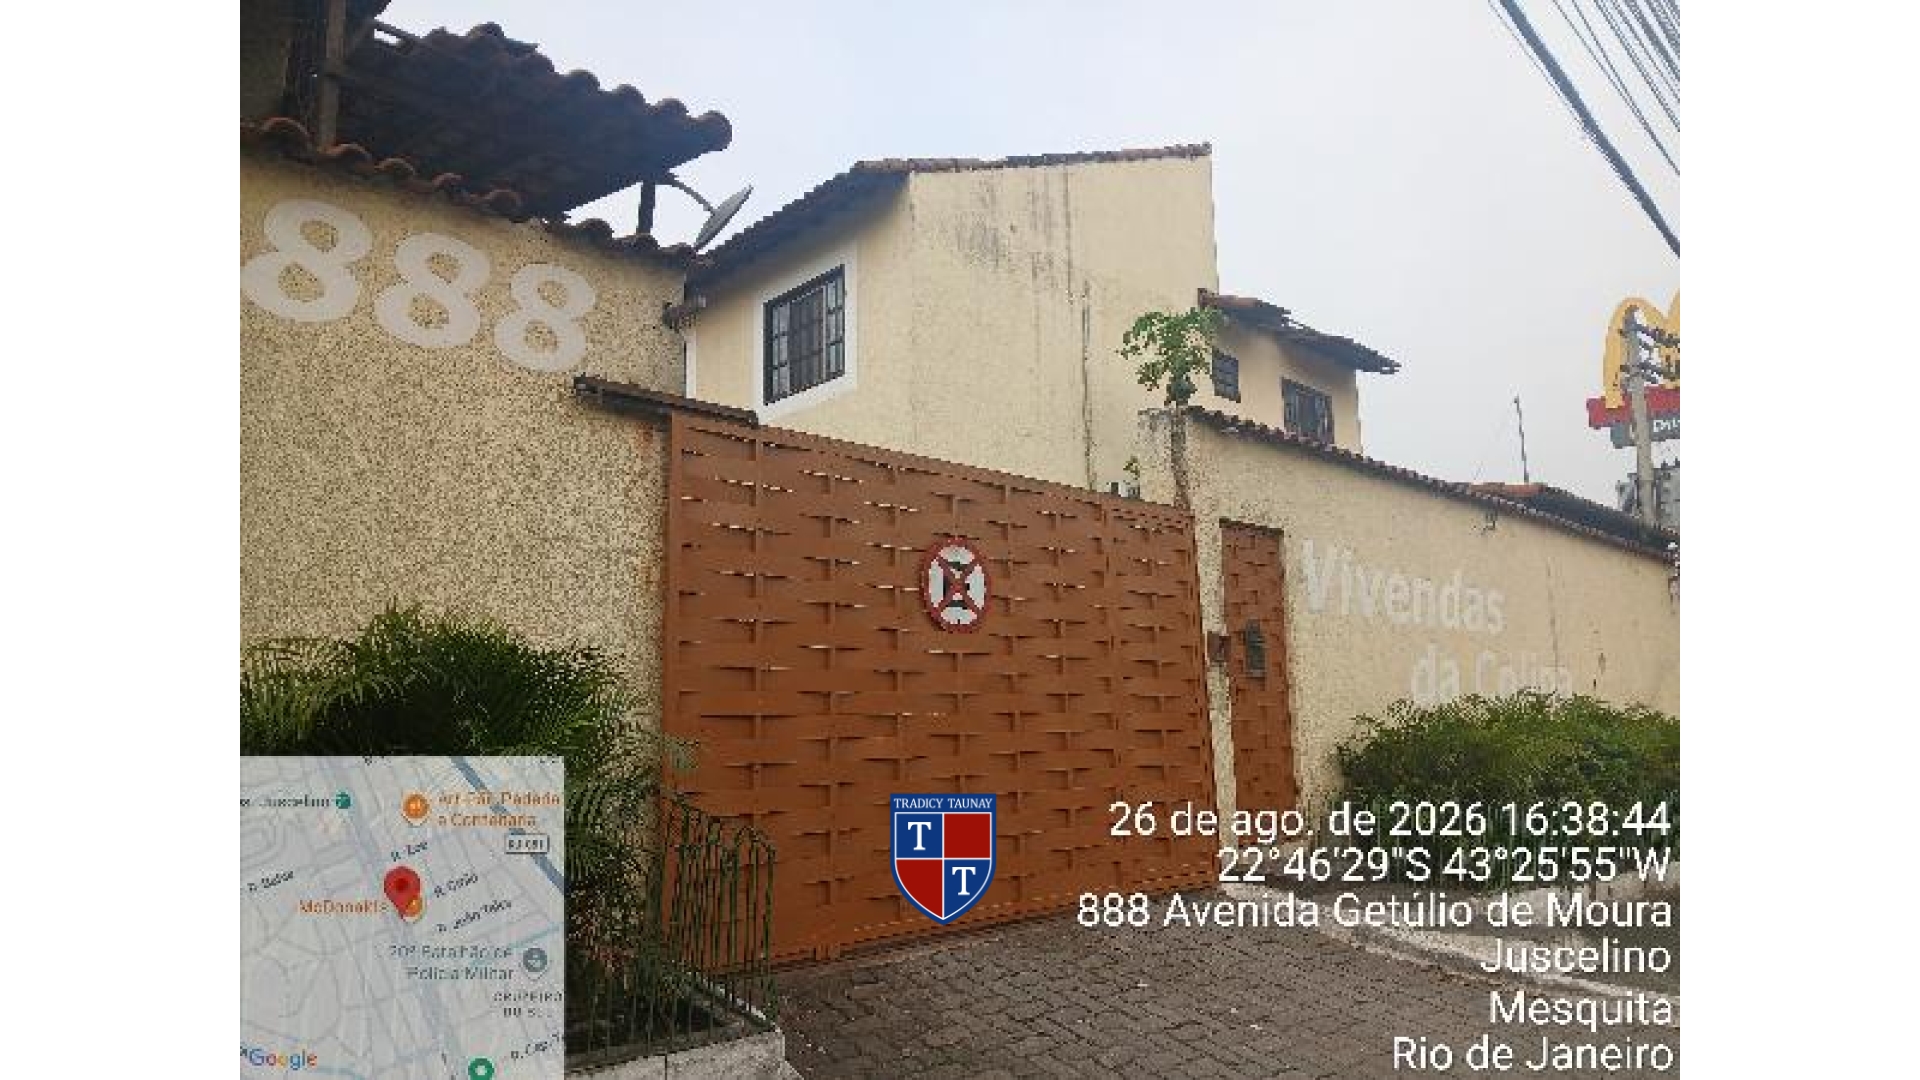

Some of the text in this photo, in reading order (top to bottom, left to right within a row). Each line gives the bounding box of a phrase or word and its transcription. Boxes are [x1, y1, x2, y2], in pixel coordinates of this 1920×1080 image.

[241, 199, 597, 372] 888
[1302, 539, 1506, 635] Vivendas
[1410, 642, 1461, 707] da
